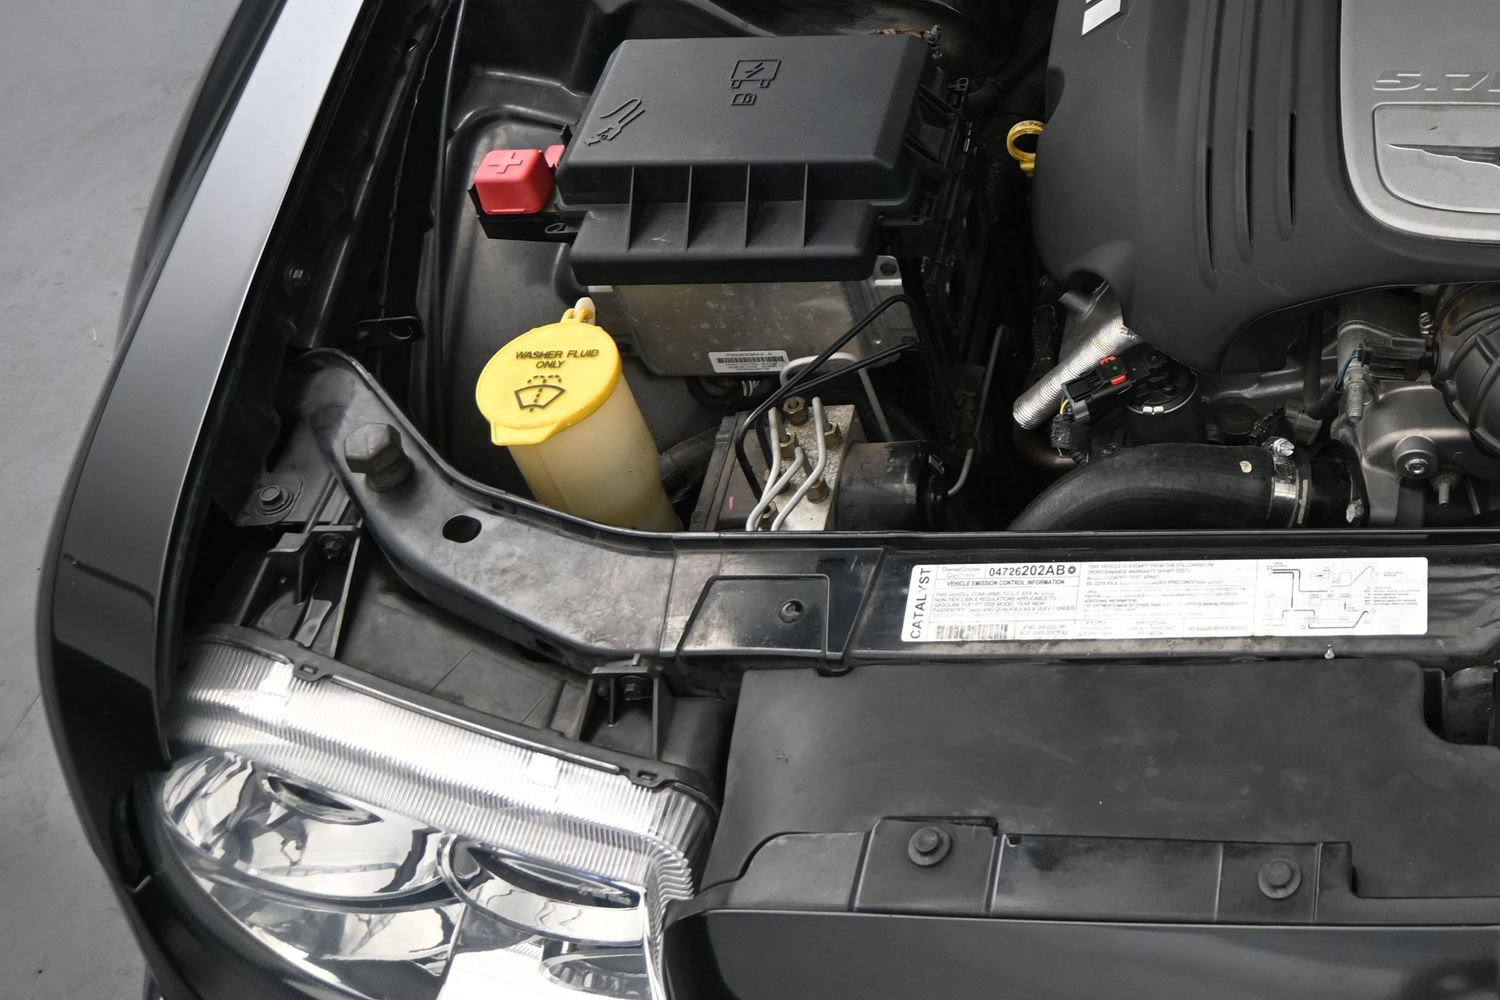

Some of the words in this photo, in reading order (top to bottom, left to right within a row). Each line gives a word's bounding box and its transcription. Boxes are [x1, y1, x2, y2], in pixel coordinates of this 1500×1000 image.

[515, 350, 563, 359] WASHER
[566, 349, 599, 358] FLUID
[535, 360, 565, 369] ONLY
[989, 565, 1065, 576] 04726202AB
[910, 568, 931, 639] CATALYST
